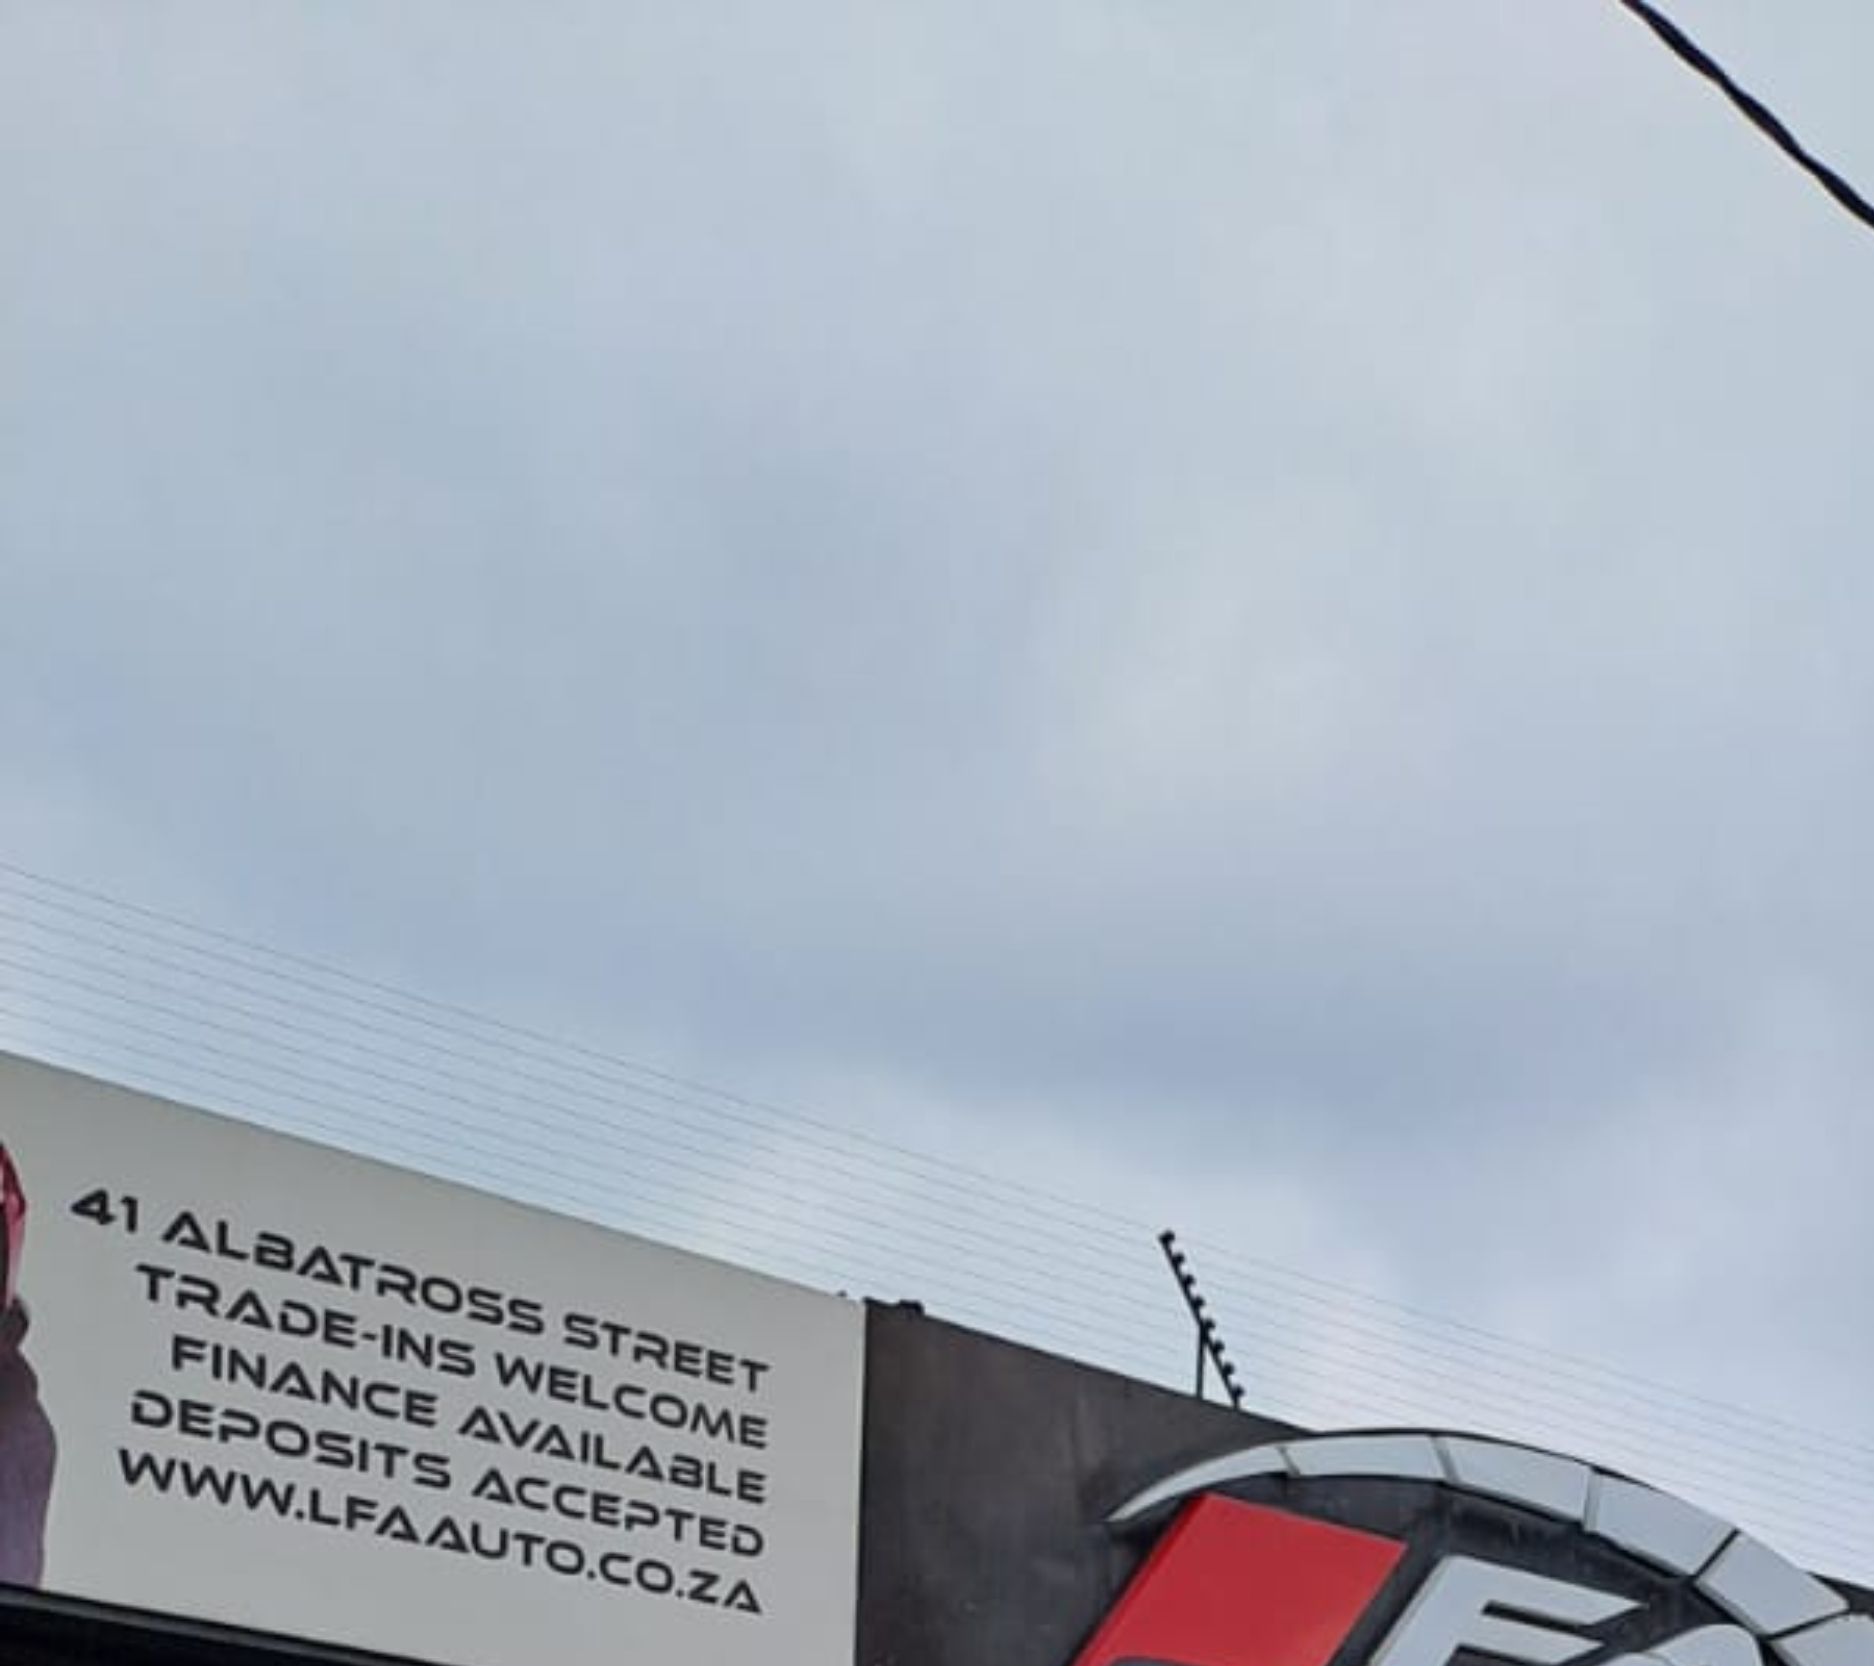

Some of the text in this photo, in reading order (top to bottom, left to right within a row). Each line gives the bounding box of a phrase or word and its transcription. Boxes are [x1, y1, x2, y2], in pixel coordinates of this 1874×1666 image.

[71, 1189, 770, 1393] 41 ALBATROSS STREET
[136, 1263, 768, 1449] TRADE-INS WELCOME
[131, 1390, 765, 1559] DEPOSITS ACCEPTED
[172, 1334, 767, 1503] FINANCE AVAILABLE
[119, 1447, 763, 1615] WWW.LFAAUTO.CO.ZA
